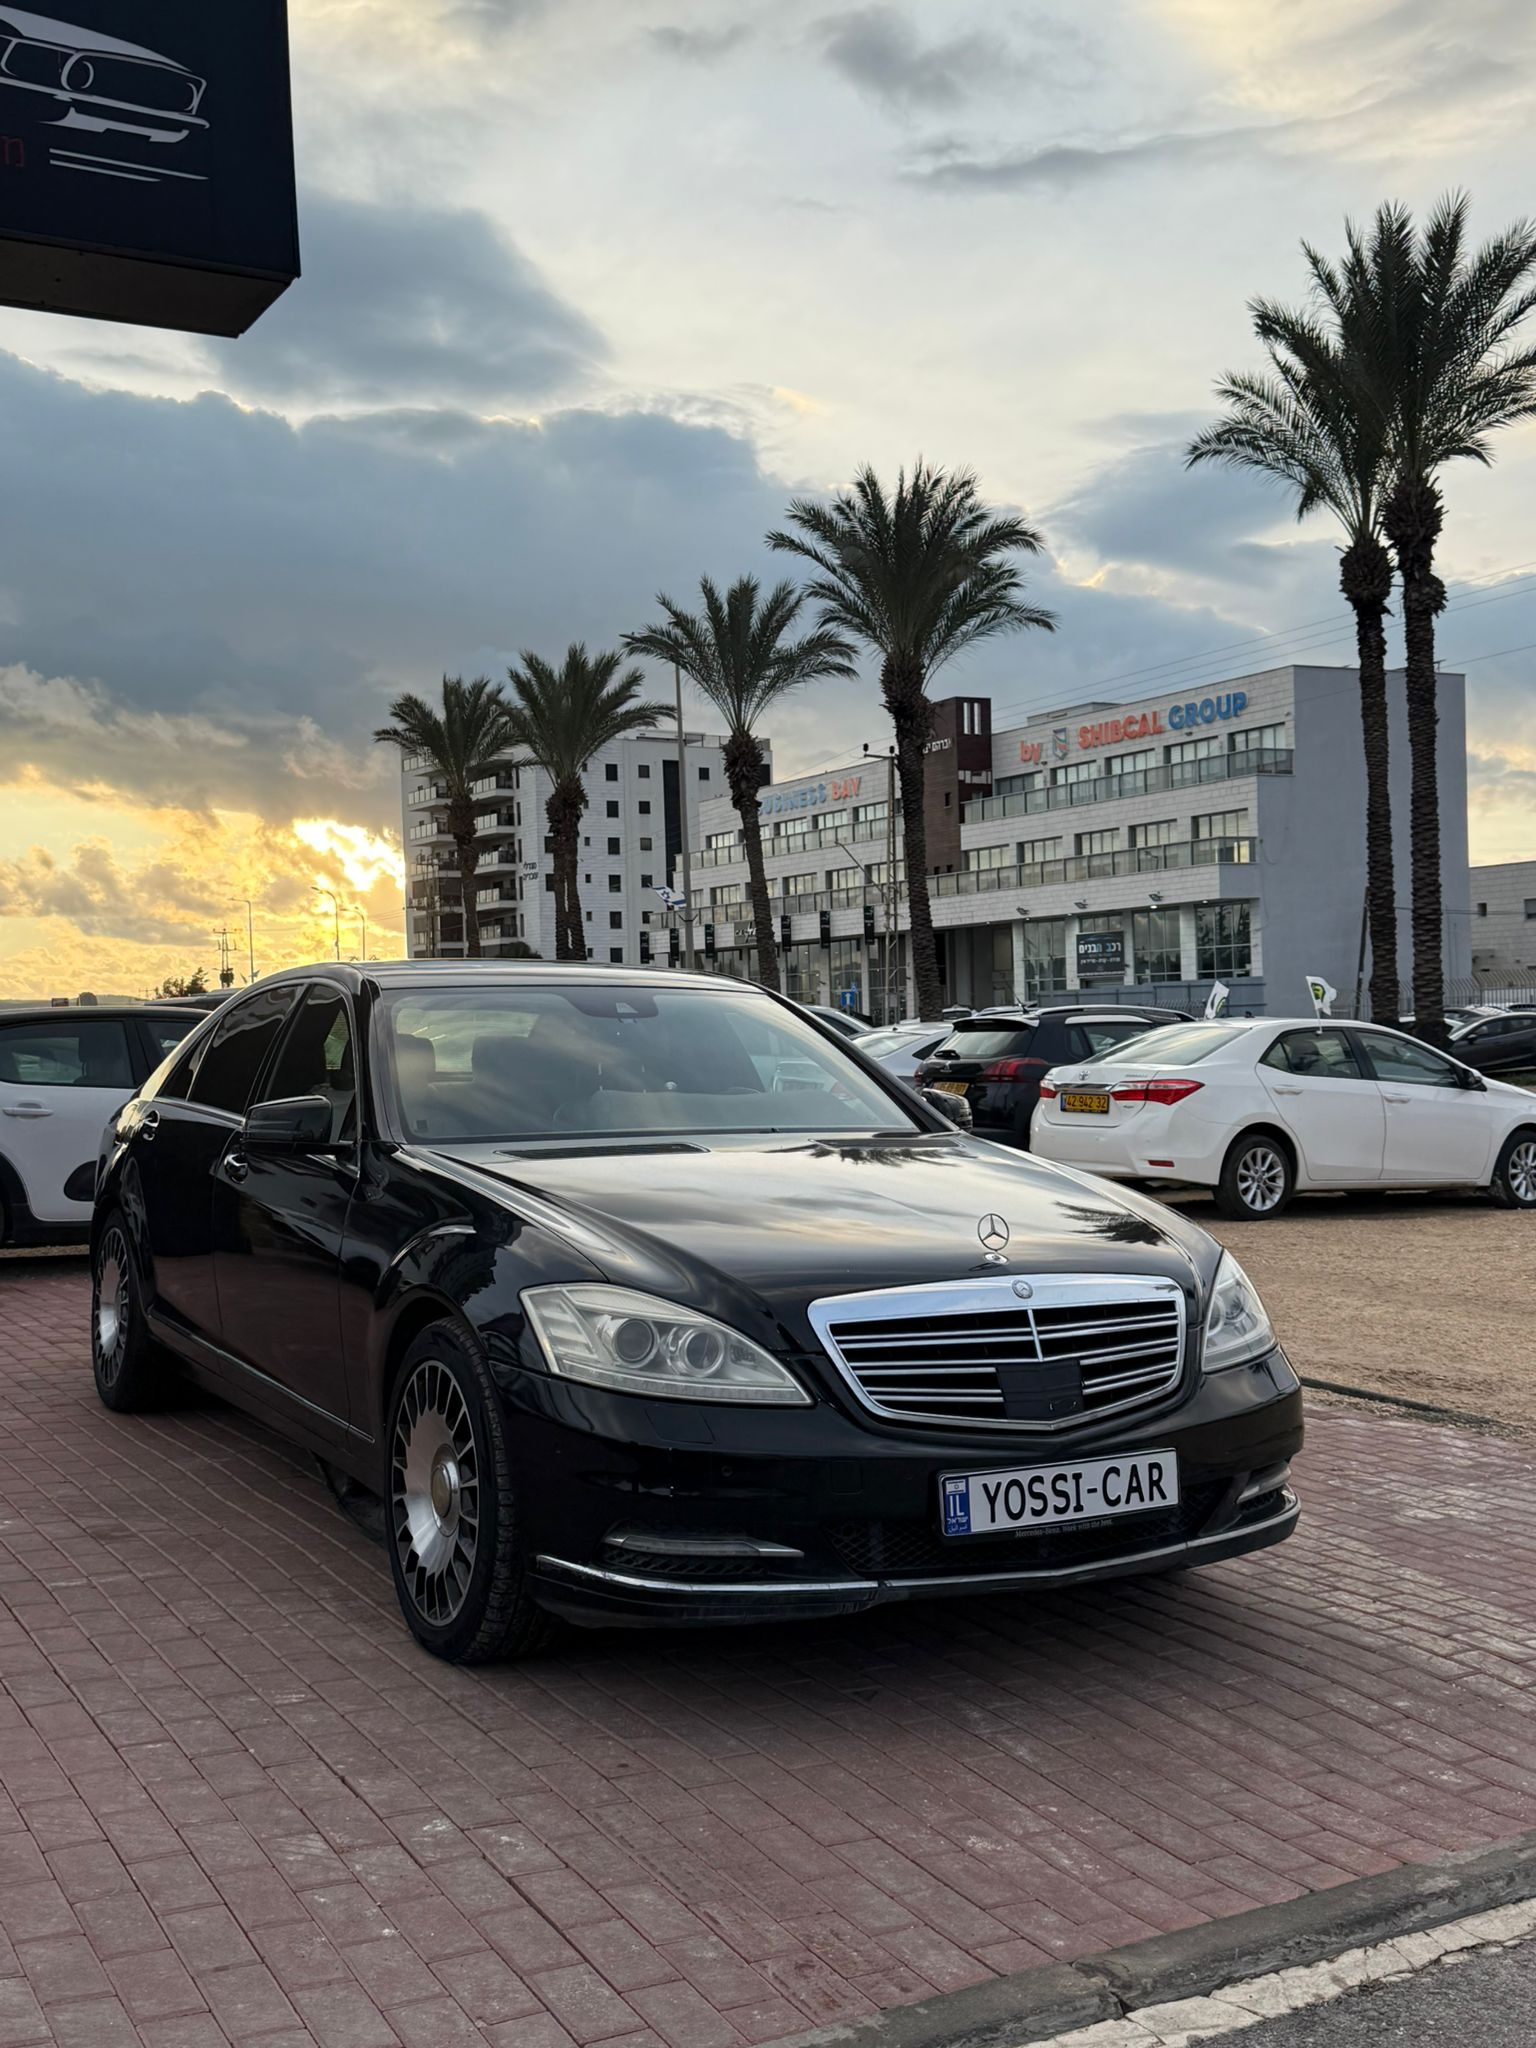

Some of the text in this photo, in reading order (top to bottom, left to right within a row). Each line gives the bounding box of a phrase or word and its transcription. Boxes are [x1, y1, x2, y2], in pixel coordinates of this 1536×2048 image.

[1019, 691, 1248, 765] by SHIBCAL GROUP
[832, 776, 862, 801] BAY
[949, 1494, 965, 1517] IL
[982, 1462, 1167, 1523] YOSSI-CAR
